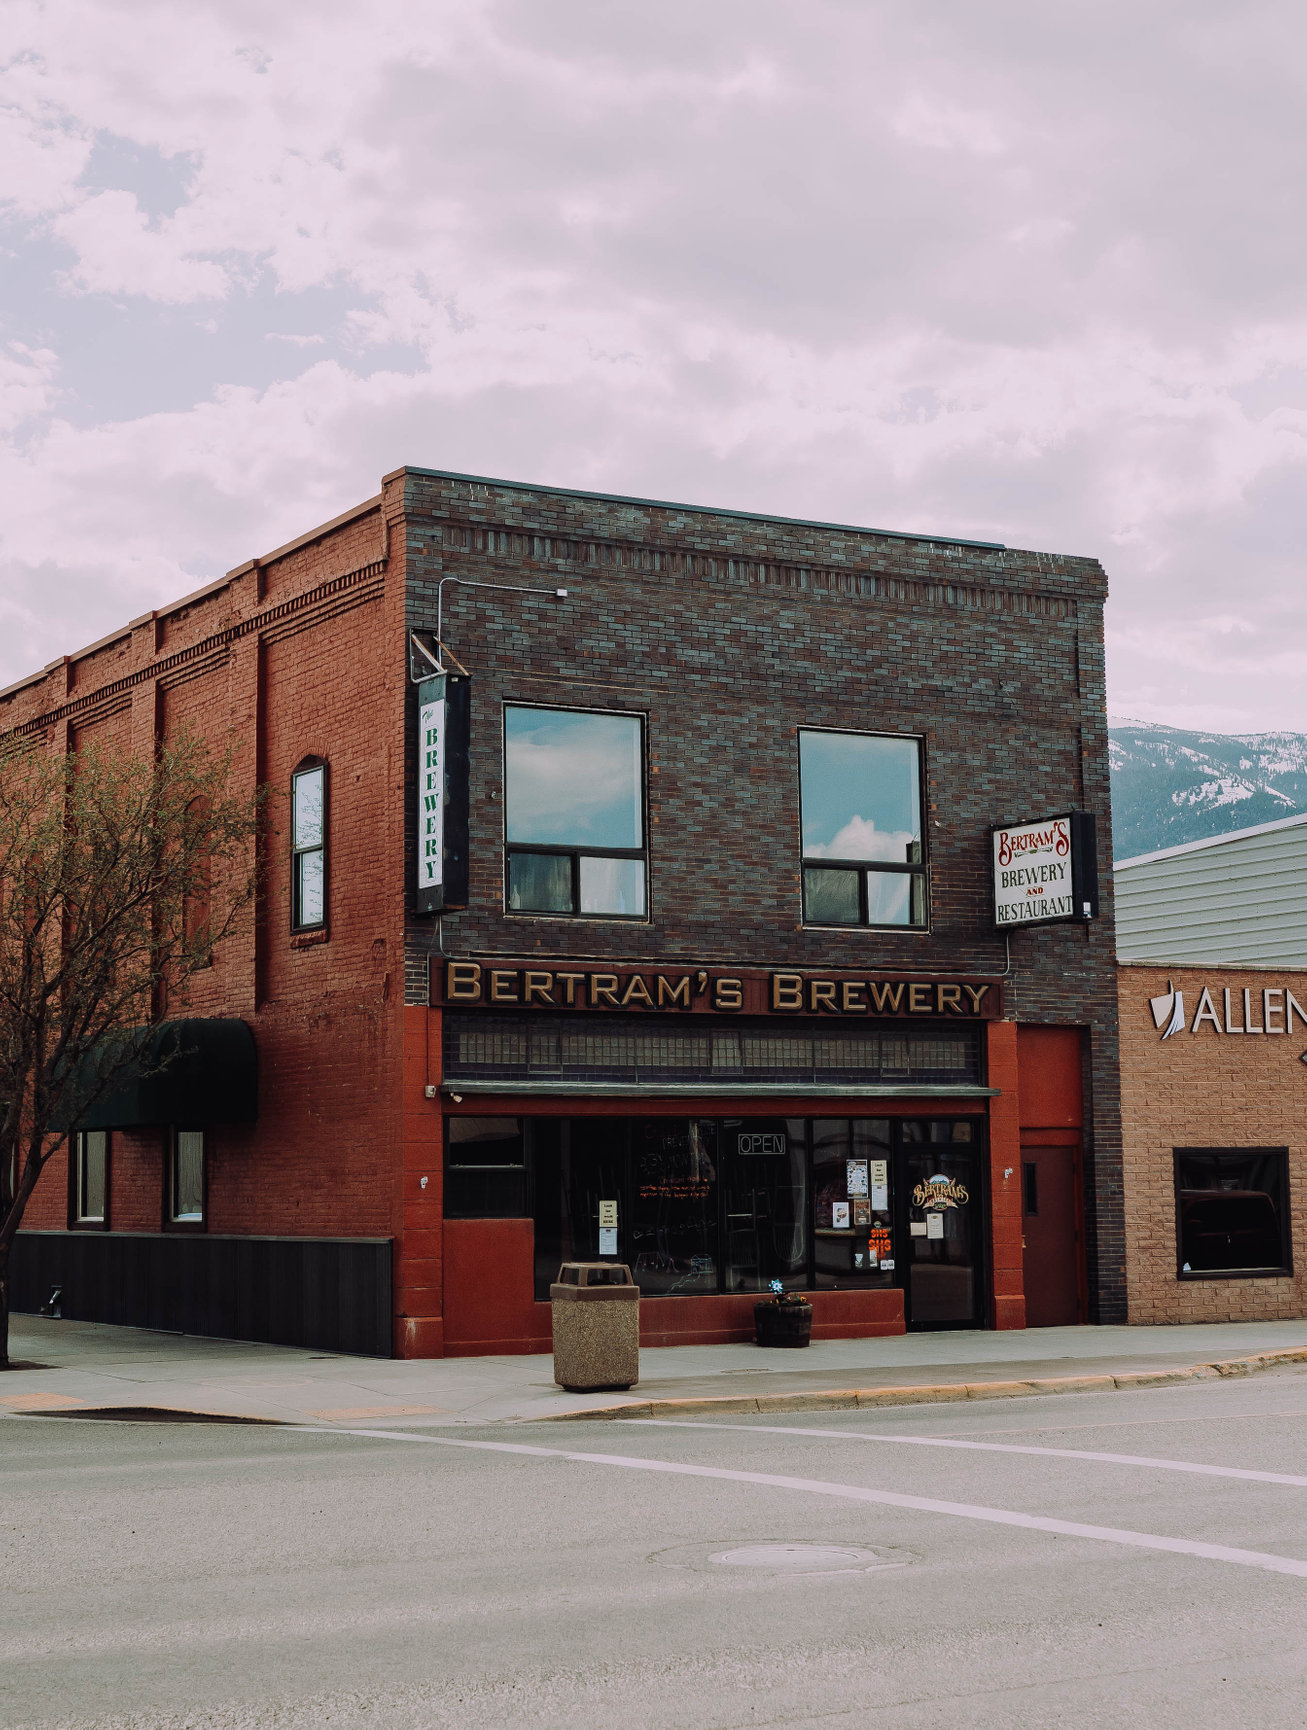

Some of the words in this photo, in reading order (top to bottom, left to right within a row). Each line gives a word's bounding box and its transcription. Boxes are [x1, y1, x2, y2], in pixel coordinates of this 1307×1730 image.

[424, 727, 440, 880] BREWERY
[998, 821, 1070, 867] BERTRAM'S
[1001, 862, 1067, 889] BREWERY
[1026, 886, 1044, 896] AND
[998, 895, 1073, 922] RESTAURANT
[447, 961, 743, 1010] BERTRAM'S
[772, 973, 990, 1014] BREWERY
[1191, 985, 1307, 1035] ALLEN
[740, 1135, 784, 1153] OPEN
